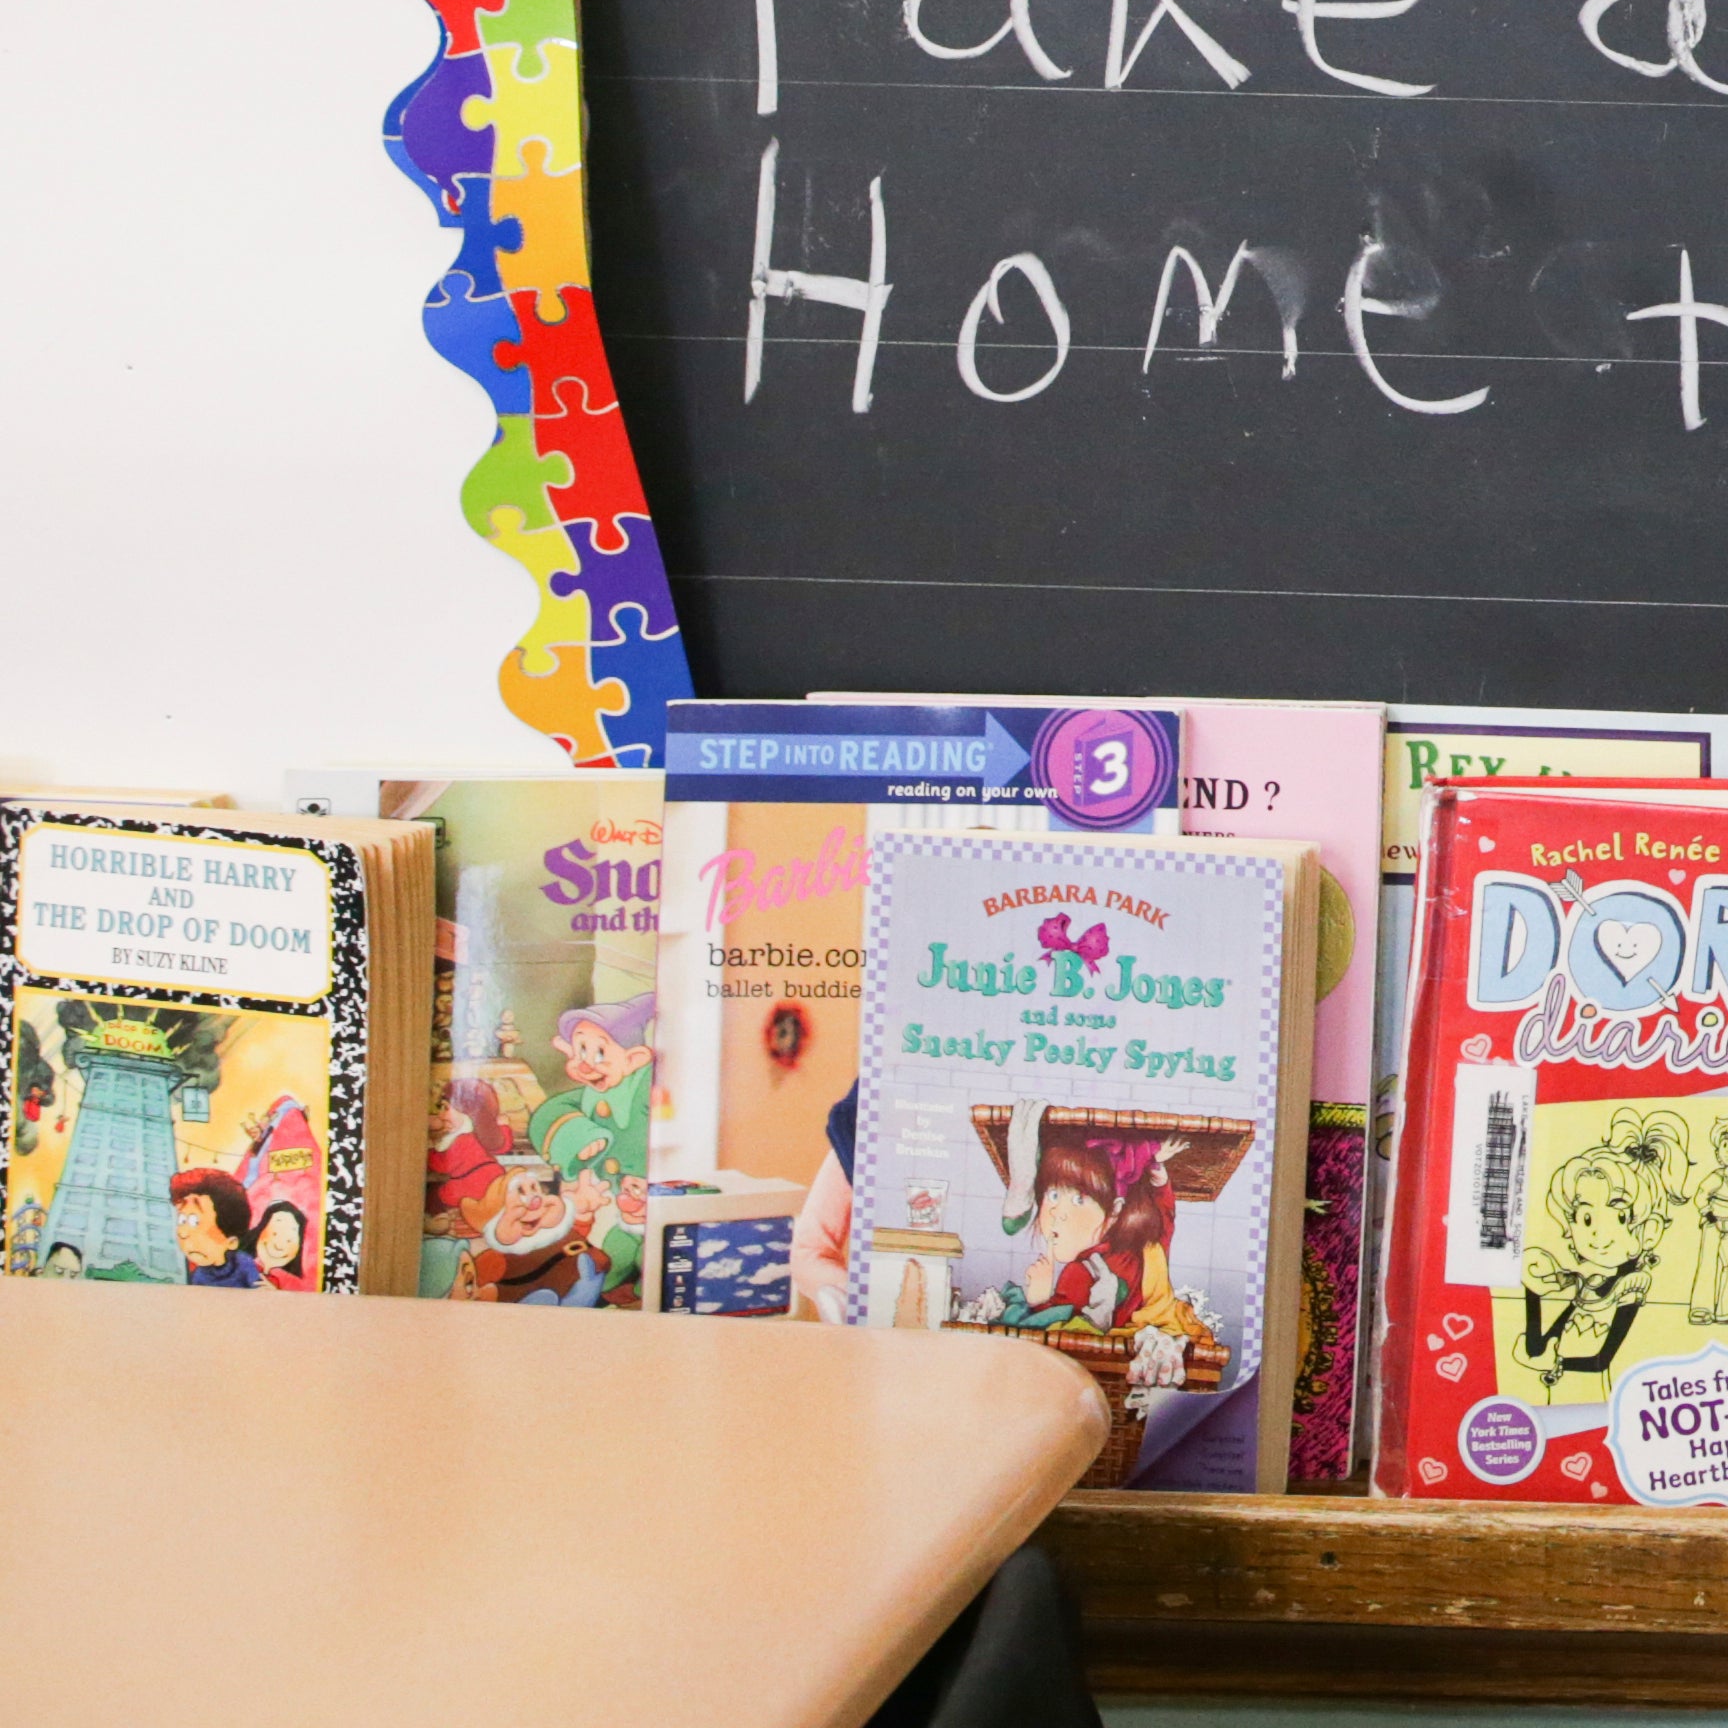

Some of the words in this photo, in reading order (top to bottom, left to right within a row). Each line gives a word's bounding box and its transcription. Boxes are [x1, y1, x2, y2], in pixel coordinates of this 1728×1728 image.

[744, 138, 1490, 413] Home
[700, 739, 778, 769] STEP
[785, 745, 835, 765] INTO
[840, 741, 987, 772] READING
[1090, 740, 1129, 795] 3
[1072, 752, 1083, 796] STEP
[888, 783, 950, 800] reading
[956, 785, 976, 798] on
[981, 785, 1019, 802] your
[1023, 787, 1058, 799] own
[1531, 833, 1624, 867] Rachel
[1635, 833, 1720, 862] Renée
[50, 844, 193, 882] HORRIBLE
[204, 859, 296, 892] HARRY
[539, 838, 661, 906] Sno
[148, 886, 194, 909] AND
[982, 884, 1098, 918] BARBARA
[1105, 889, 1170, 930] PARK
[33, 902, 86, 931] THE
[96, 908, 173, 939] DROP
[183, 917, 220, 944] OF
[229, 924, 312, 954] DOOM
[570, 907, 625, 933] and
[112, 947, 132, 965] BY
[136, 950, 176, 970] SUZY
[180, 953, 228, 975] KLINE
[706, 980, 773, 997] ballet
[783, 980, 861, 998] buddie
[918, 942, 1037, 996] Junie
[1050, 950, 1094, 999] B.
[1105, 955, 1225, 1009] Jones
[1020, 1006, 1058, 1026] and
[1064, 1010, 1117, 1028] some
[103, 1033, 164, 1054] DOOM
[902, 1024, 1016, 1066] Sneaky
[1024, 1032, 1118, 1073] Peeky
[1125, 1039, 1236, 1081] Spying
[1642, 1377, 1707, 1402] Tales
[1487, 1412, 1512, 1422] New
[1471, 1426, 1497, 1438] York
[1498, 1425, 1530, 1435] Times
[1471, 1439, 1532, 1452] Bestselling
[1485, 1454, 1520, 1465] Series
